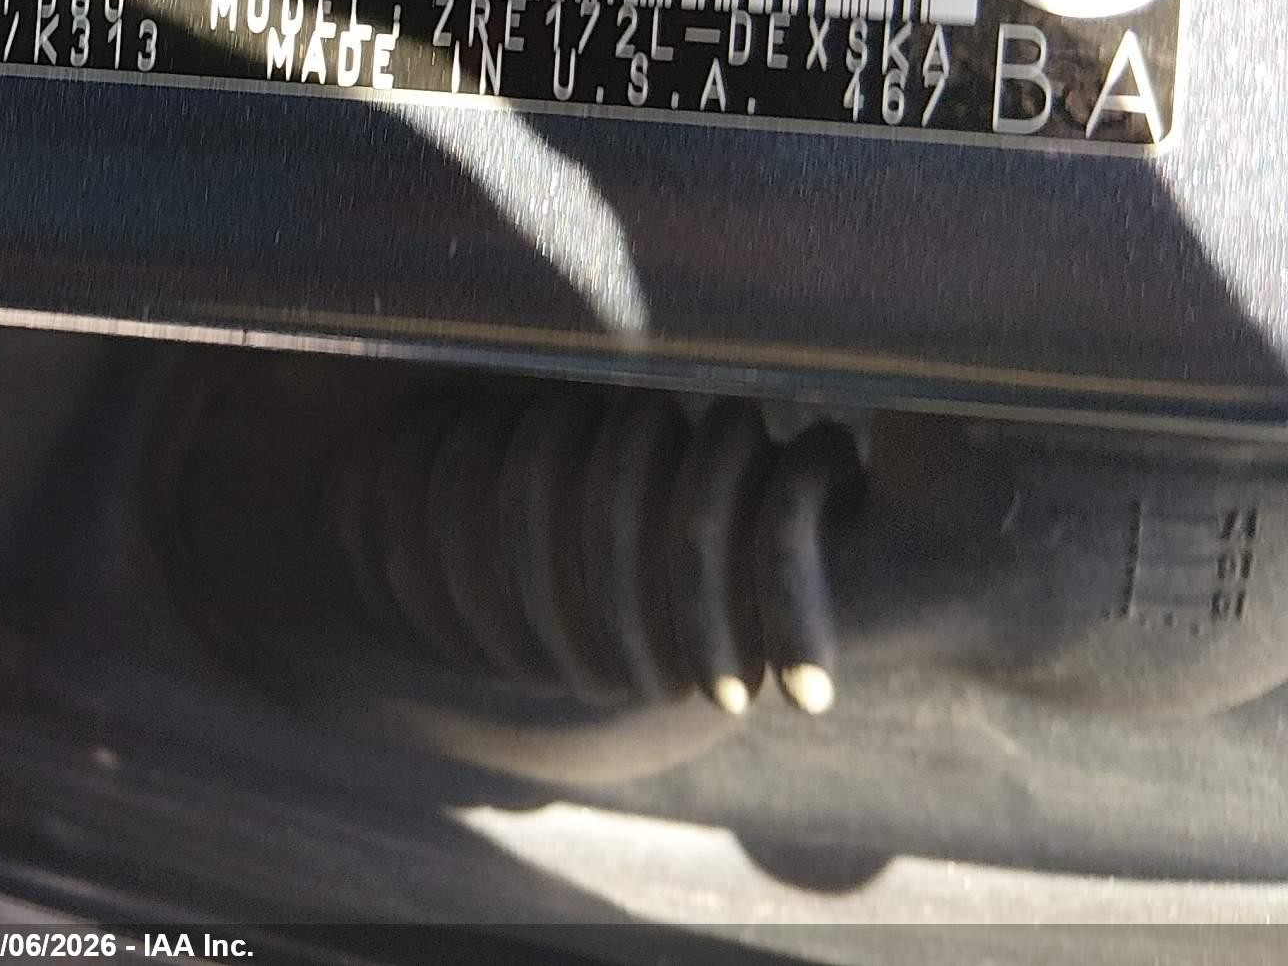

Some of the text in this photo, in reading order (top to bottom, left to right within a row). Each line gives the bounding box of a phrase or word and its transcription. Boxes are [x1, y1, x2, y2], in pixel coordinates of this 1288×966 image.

[267, 27, 398, 90] MADE
[452, 41, 503, 96] IN
[553, 47, 756, 115] U.S.A.
[843, 68, 948, 127] 467
